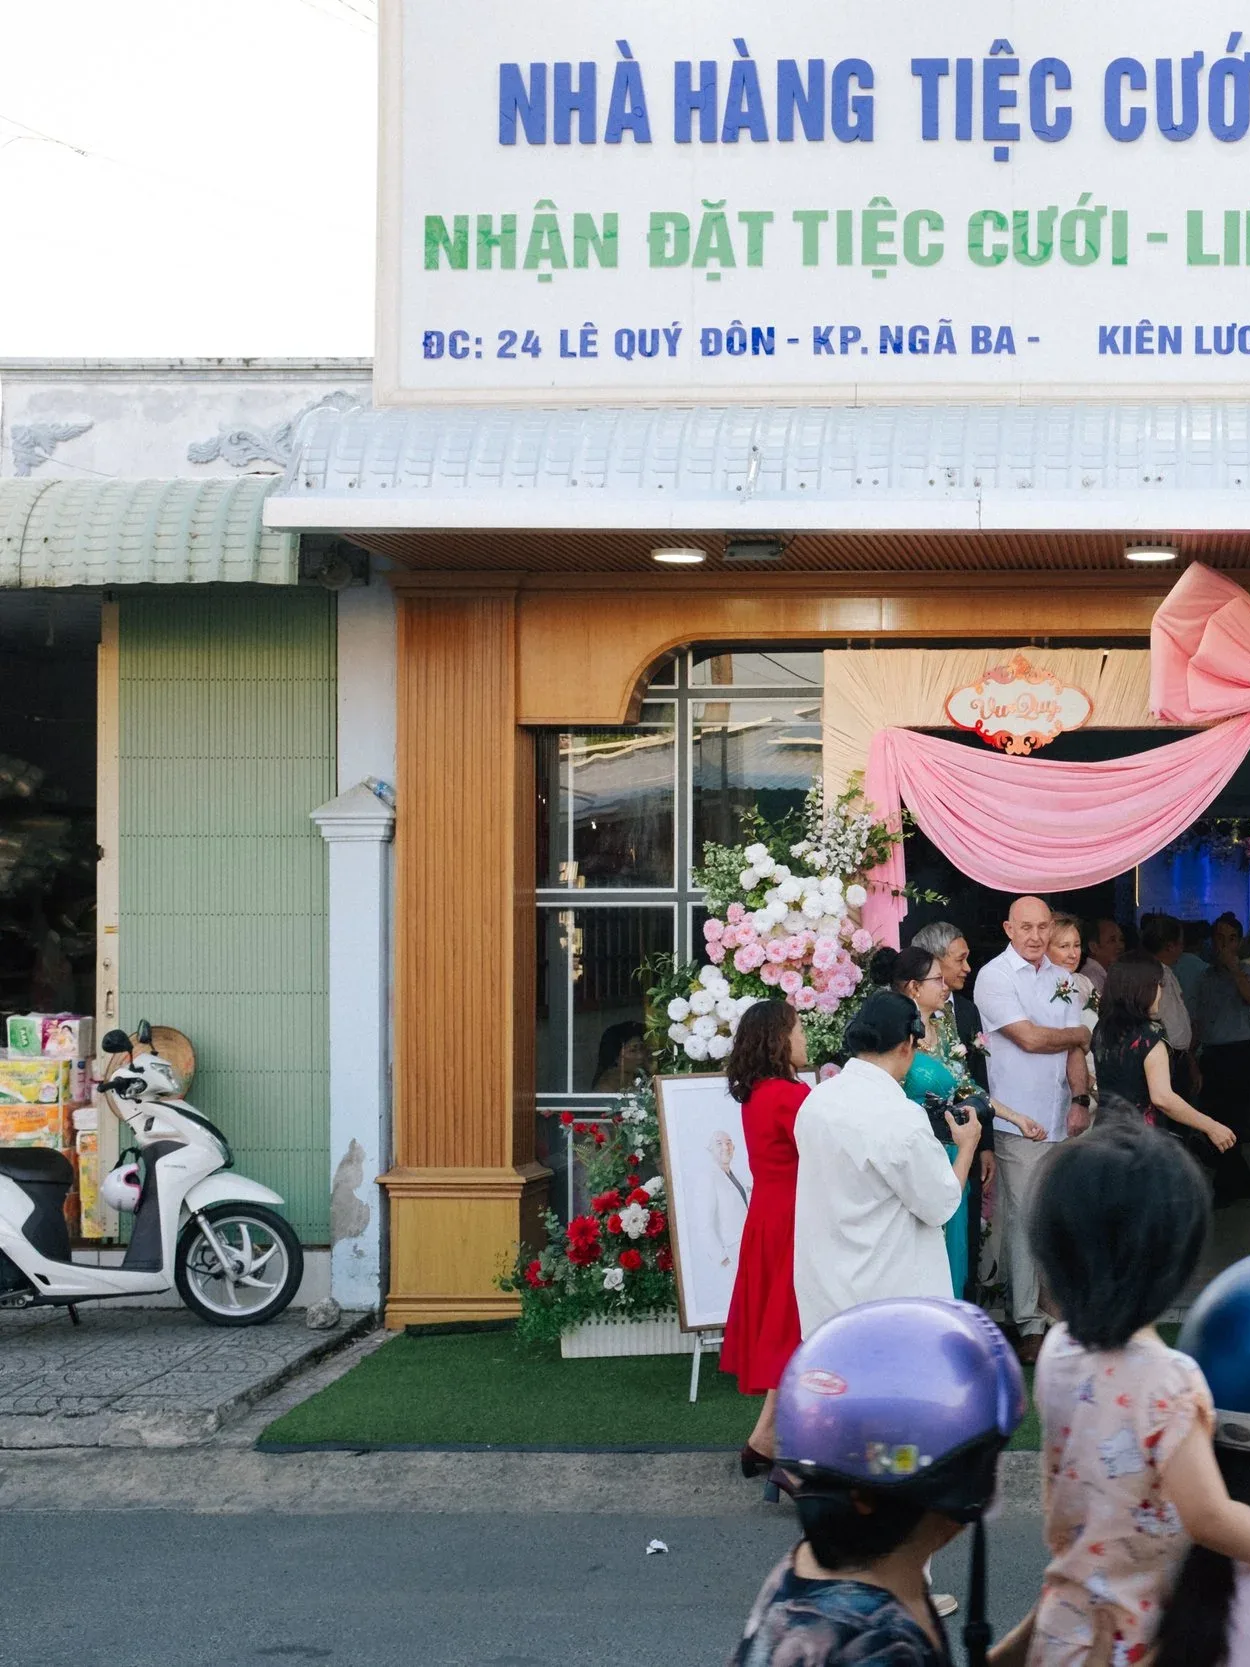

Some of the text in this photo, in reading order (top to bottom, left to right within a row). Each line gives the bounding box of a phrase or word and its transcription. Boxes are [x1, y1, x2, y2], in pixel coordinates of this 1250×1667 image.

[499, 40, 653, 145] NHÀ
[674, 38, 876, 144] HÀNG
[911, 39, 1073, 162] TIỆC
[424, 199, 619, 282] NHẬN
[648, 199, 774, 281] ĐẶT
[794, 197, 946, 279] TIỆC
[967, 193, 1129, 268] CƯỚI
[422, 330, 483, 360] ĐC:
[497, 330, 542, 359] 24
[560, 322, 599, 358] LÊ
[614, 321, 683, 360] QUÝ
[700, 320, 776, 357] ĐÔN
[971, 326, 1017, 355] BA
[1099, 319, 1183, 356] KIÊN
